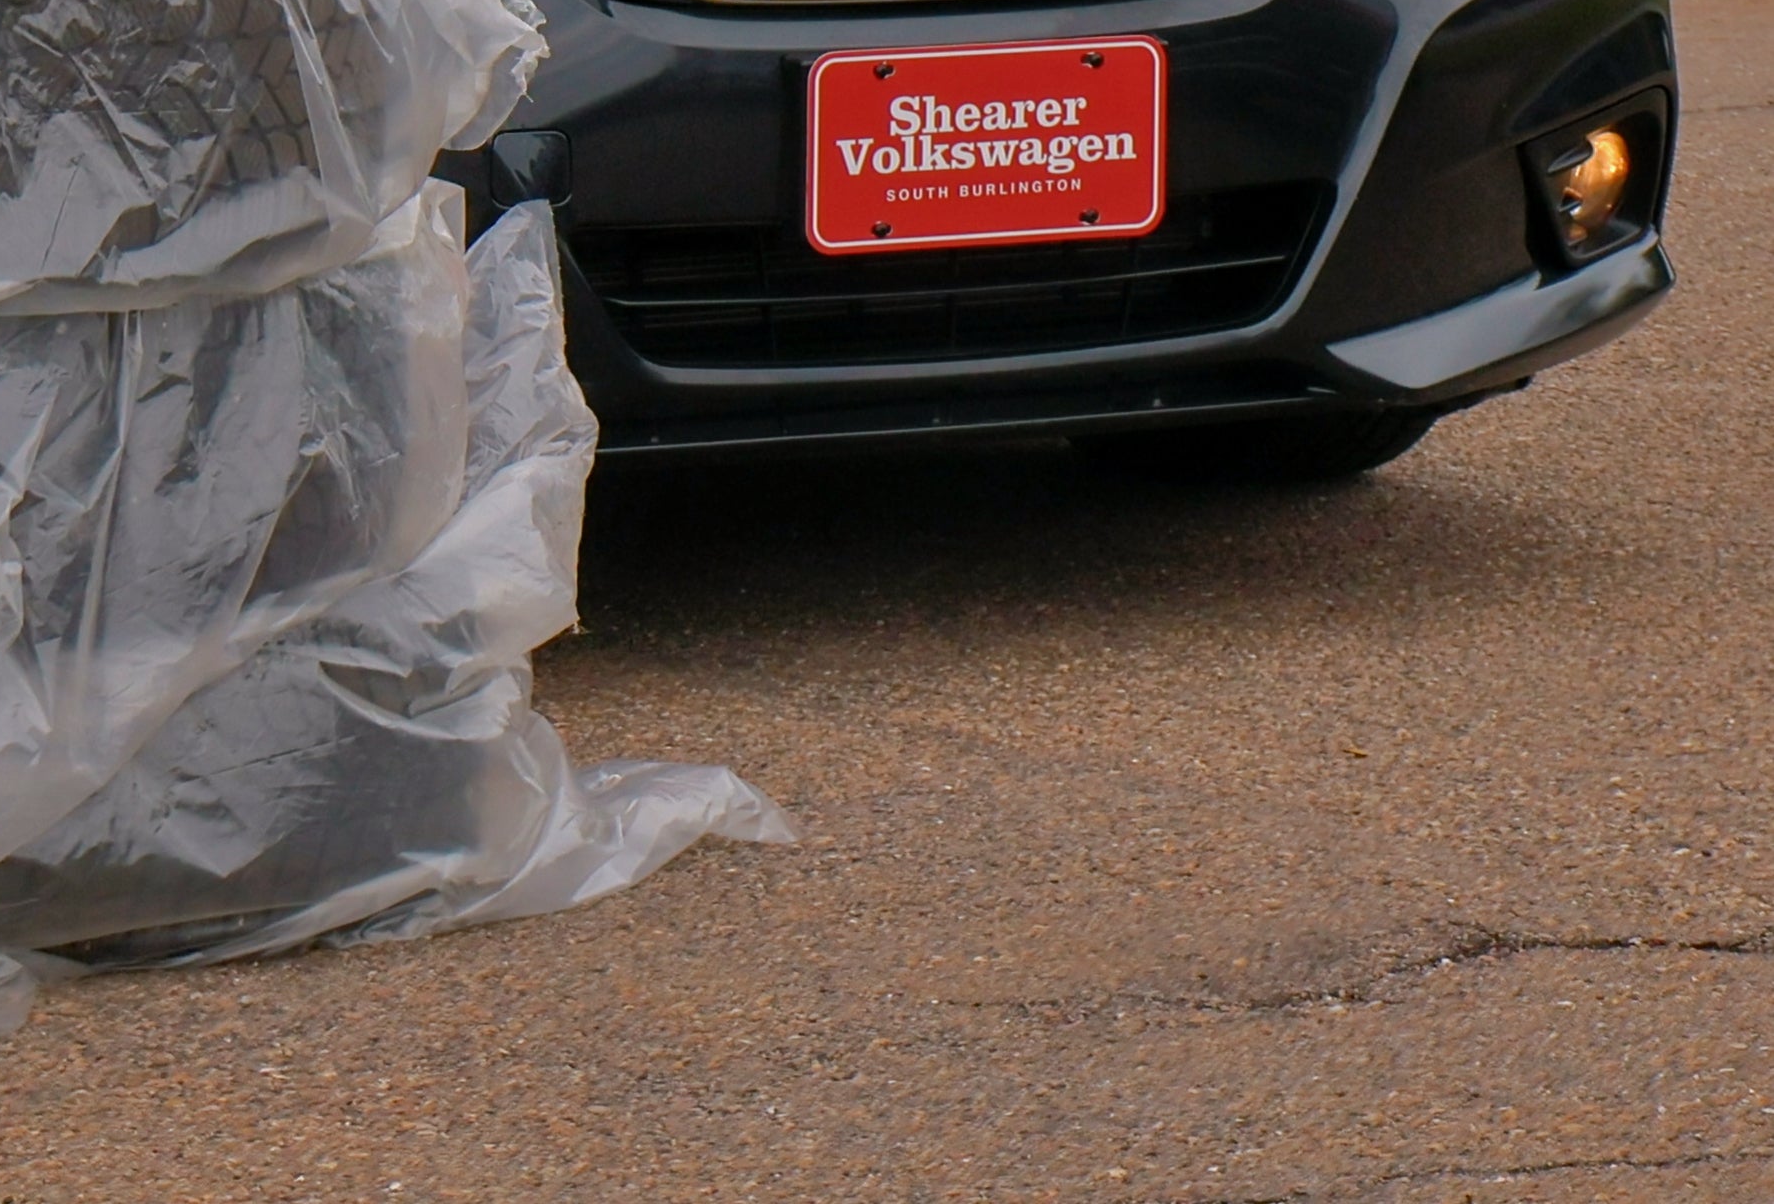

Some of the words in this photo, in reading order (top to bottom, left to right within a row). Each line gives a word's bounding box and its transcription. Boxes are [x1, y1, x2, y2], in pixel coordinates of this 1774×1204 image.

[889, 95, 1088, 137] Shearer
[836, 131, 1138, 176] Volkswagen
[886, 186, 949, 203] SOUTH
[959, 178, 1083, 198] BURLINGTON
